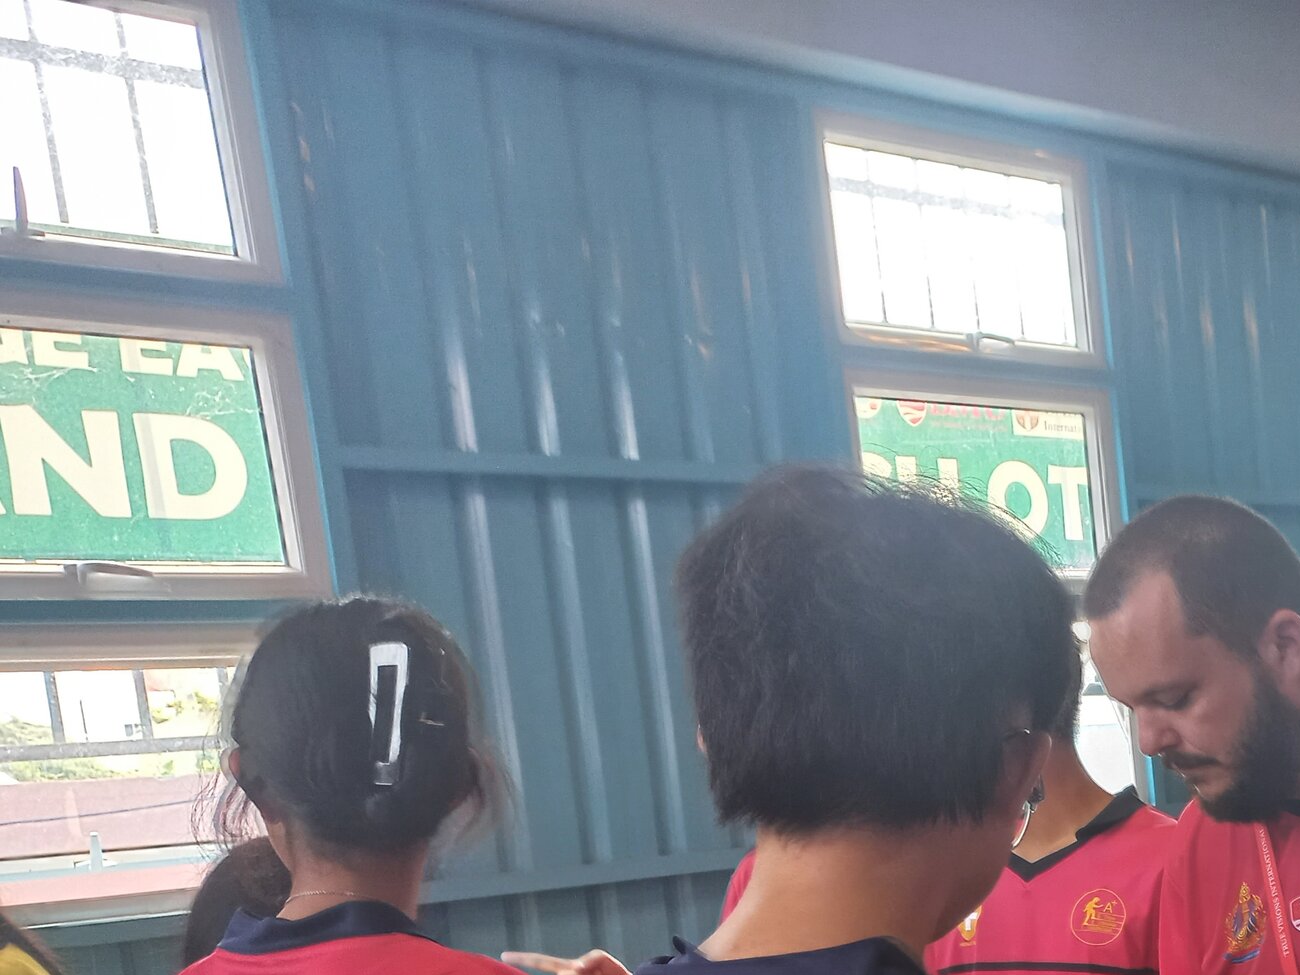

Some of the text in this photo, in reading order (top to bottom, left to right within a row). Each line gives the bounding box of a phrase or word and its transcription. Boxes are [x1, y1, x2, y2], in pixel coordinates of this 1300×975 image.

[119, 337, 251, 381] EA
[0, 403, 248, 521] ND
[1271, 897, 1284, 933] VISIONS
